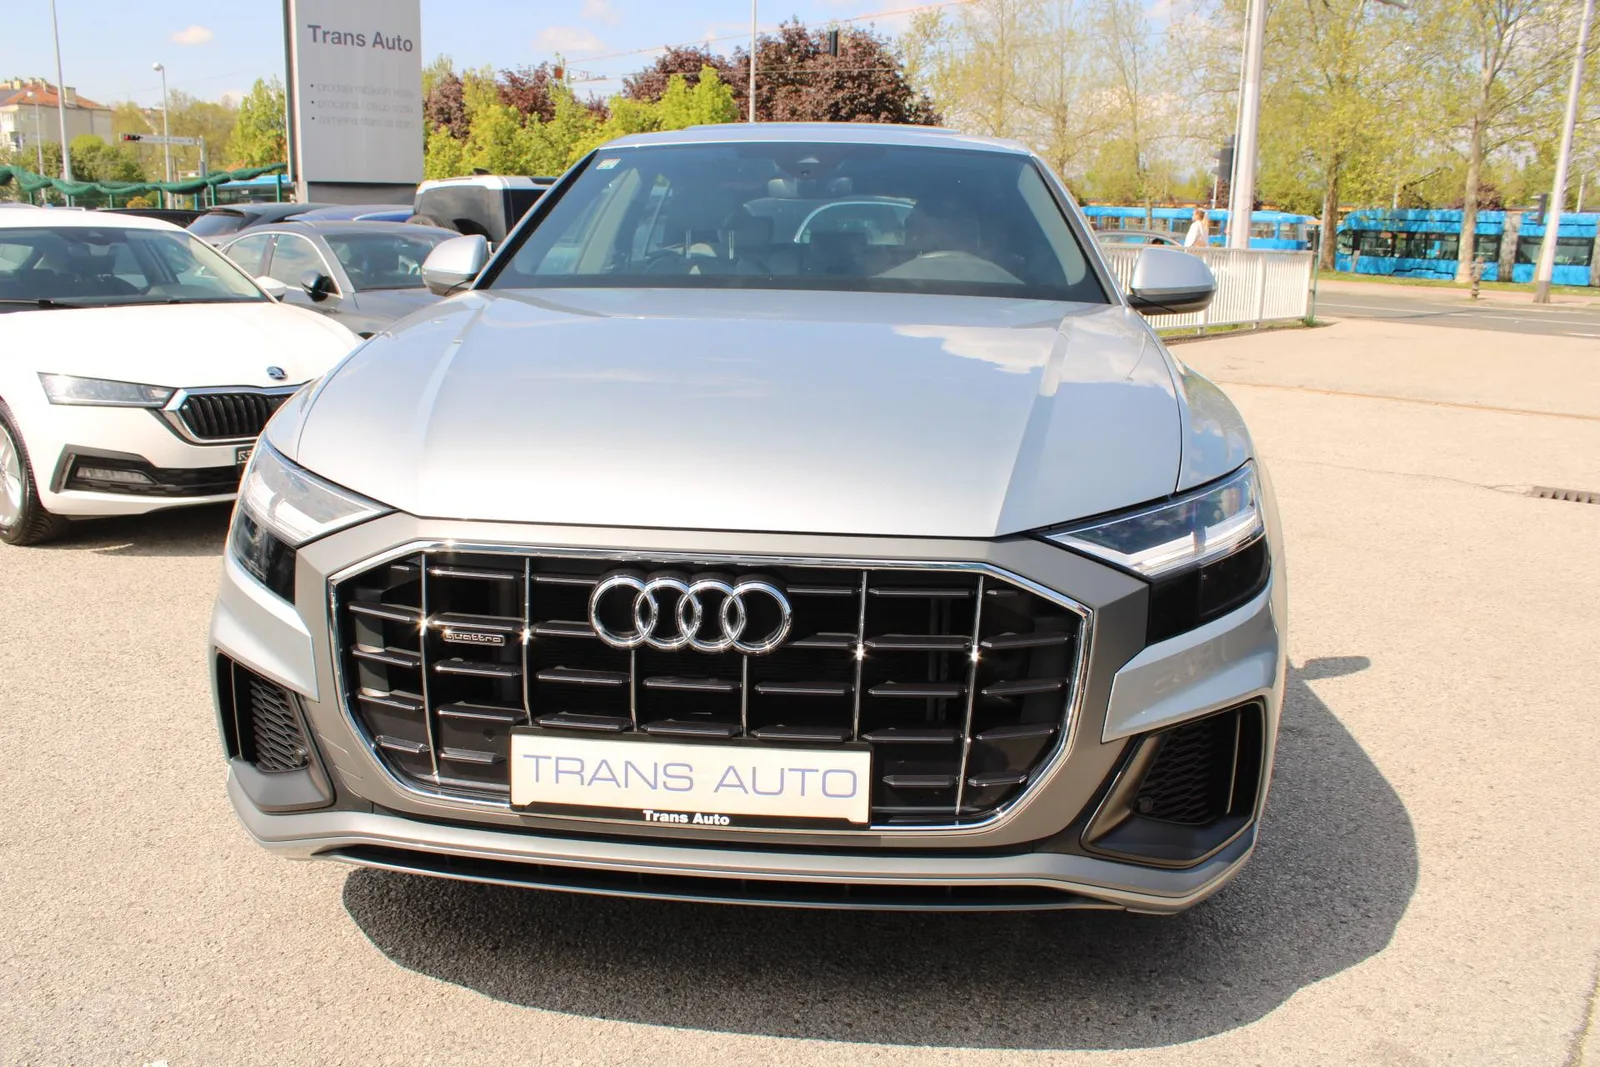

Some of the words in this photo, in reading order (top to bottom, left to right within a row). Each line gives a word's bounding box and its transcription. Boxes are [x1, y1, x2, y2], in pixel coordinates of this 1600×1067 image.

[307, 24, 366, 47] Trans
[372, 31, 413, 52] Auto
[445, 632, 502, 643] quattro
[523, 754, 694, 793] TRANS
[713, 765, 857, 798] AUTO
[642, 809, 689, 823] Trans
[692, 812, 730, 826] Auto
